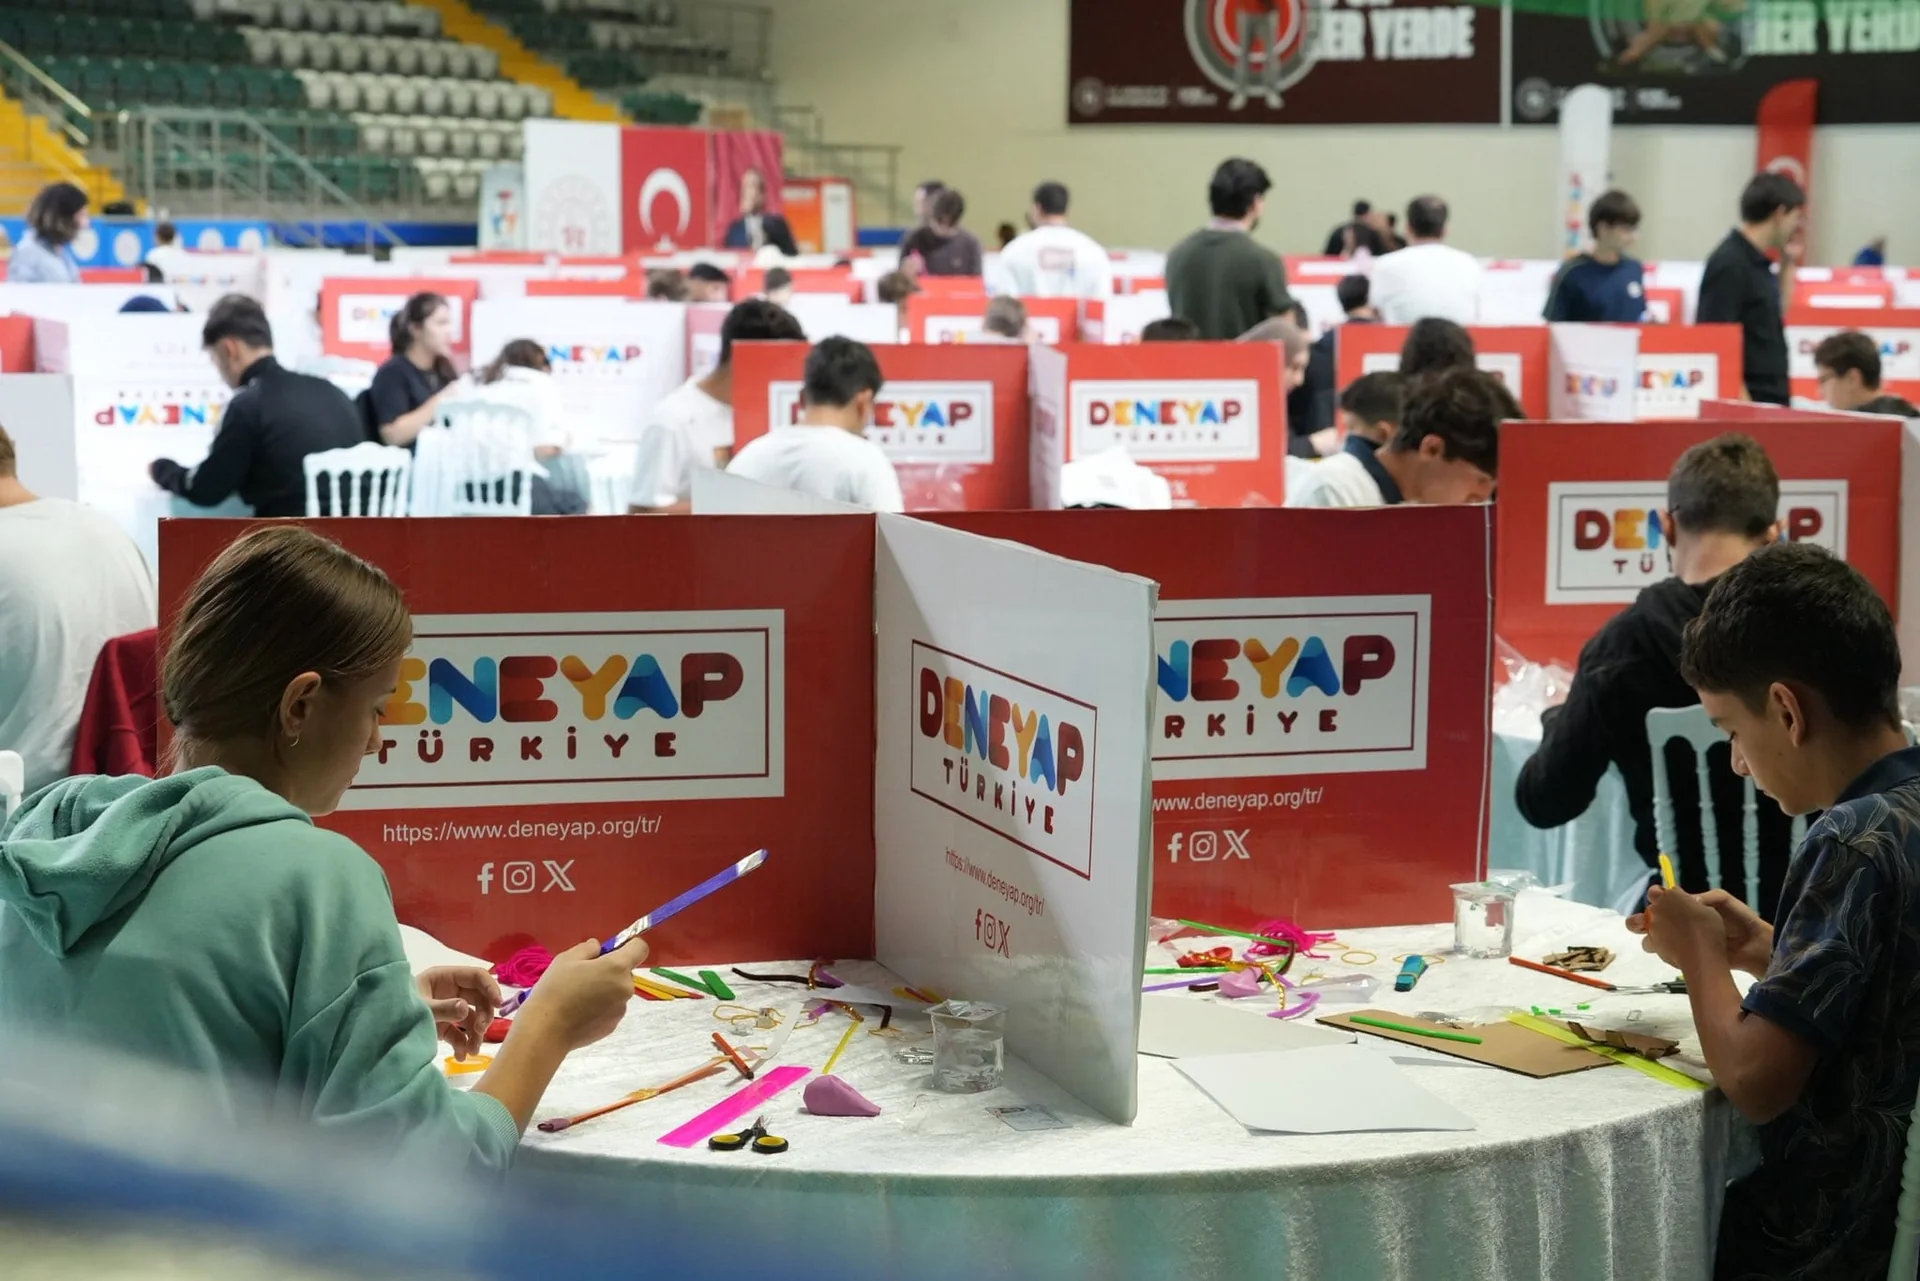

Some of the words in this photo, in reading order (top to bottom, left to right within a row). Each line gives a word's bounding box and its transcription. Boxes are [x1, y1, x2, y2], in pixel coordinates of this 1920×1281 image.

[1088, 399, 1242, 427] DENEYAP
[378, 652, 744, 726] ENEYAP
[918, 665, 1085, 797] DENEYAP
[1163, 704, 1339, 740] RKİYE
[942, 756, 1055, 836] TÜRKİYE
[1152, 787, 1324, 812] www.deneyap.org/tr/
[382, 815, 662, 845] https://www.deneyap.org/tr/
[944, 846, 1046, 917] https://www.deneyap.org/tr/
